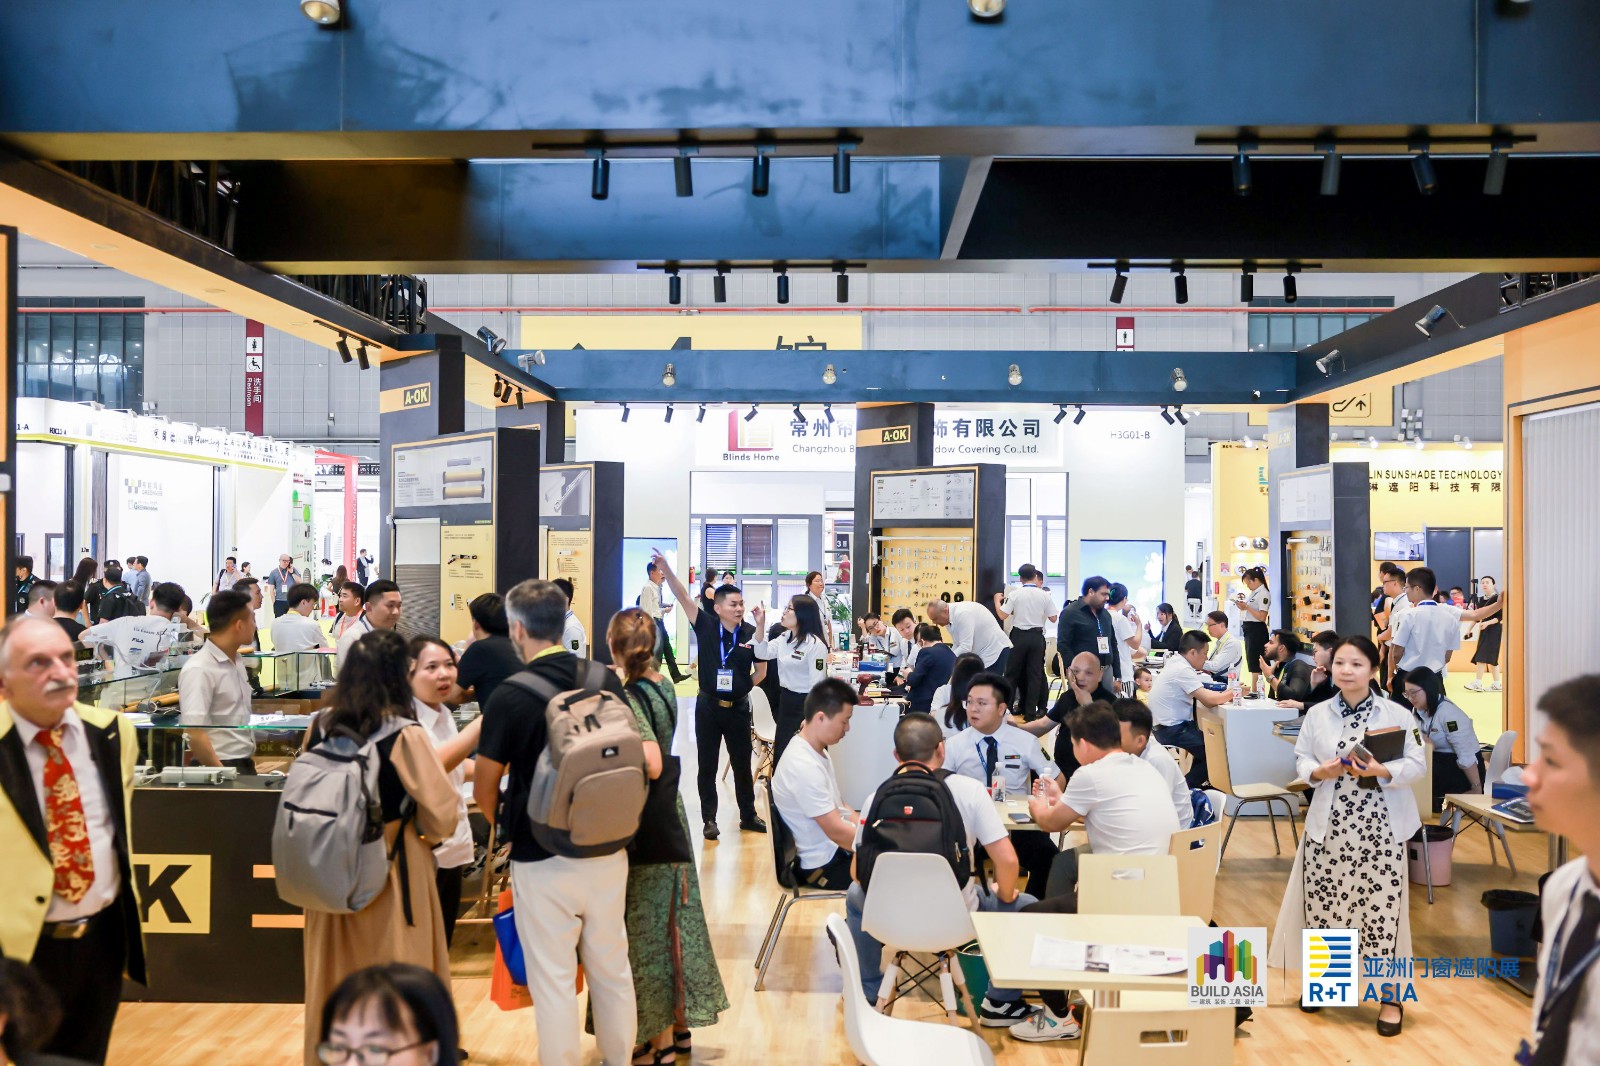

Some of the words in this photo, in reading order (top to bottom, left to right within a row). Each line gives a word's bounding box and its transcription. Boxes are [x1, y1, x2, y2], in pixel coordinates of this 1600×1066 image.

[253, 377, 262, 403] 洗手间
[1110, 431, 1150, 440] H3G01-B
[792, 444, 846, 455] Changzhou
[958, 444, 1001, 456] Covering
[722, 453, 751, 461] Blinds
[754, 453, 780, 461] Home
[1385, 470, 1436, 480] SUNSHADE
[1438, 470, 1503, 480] TECHNOLOGY
